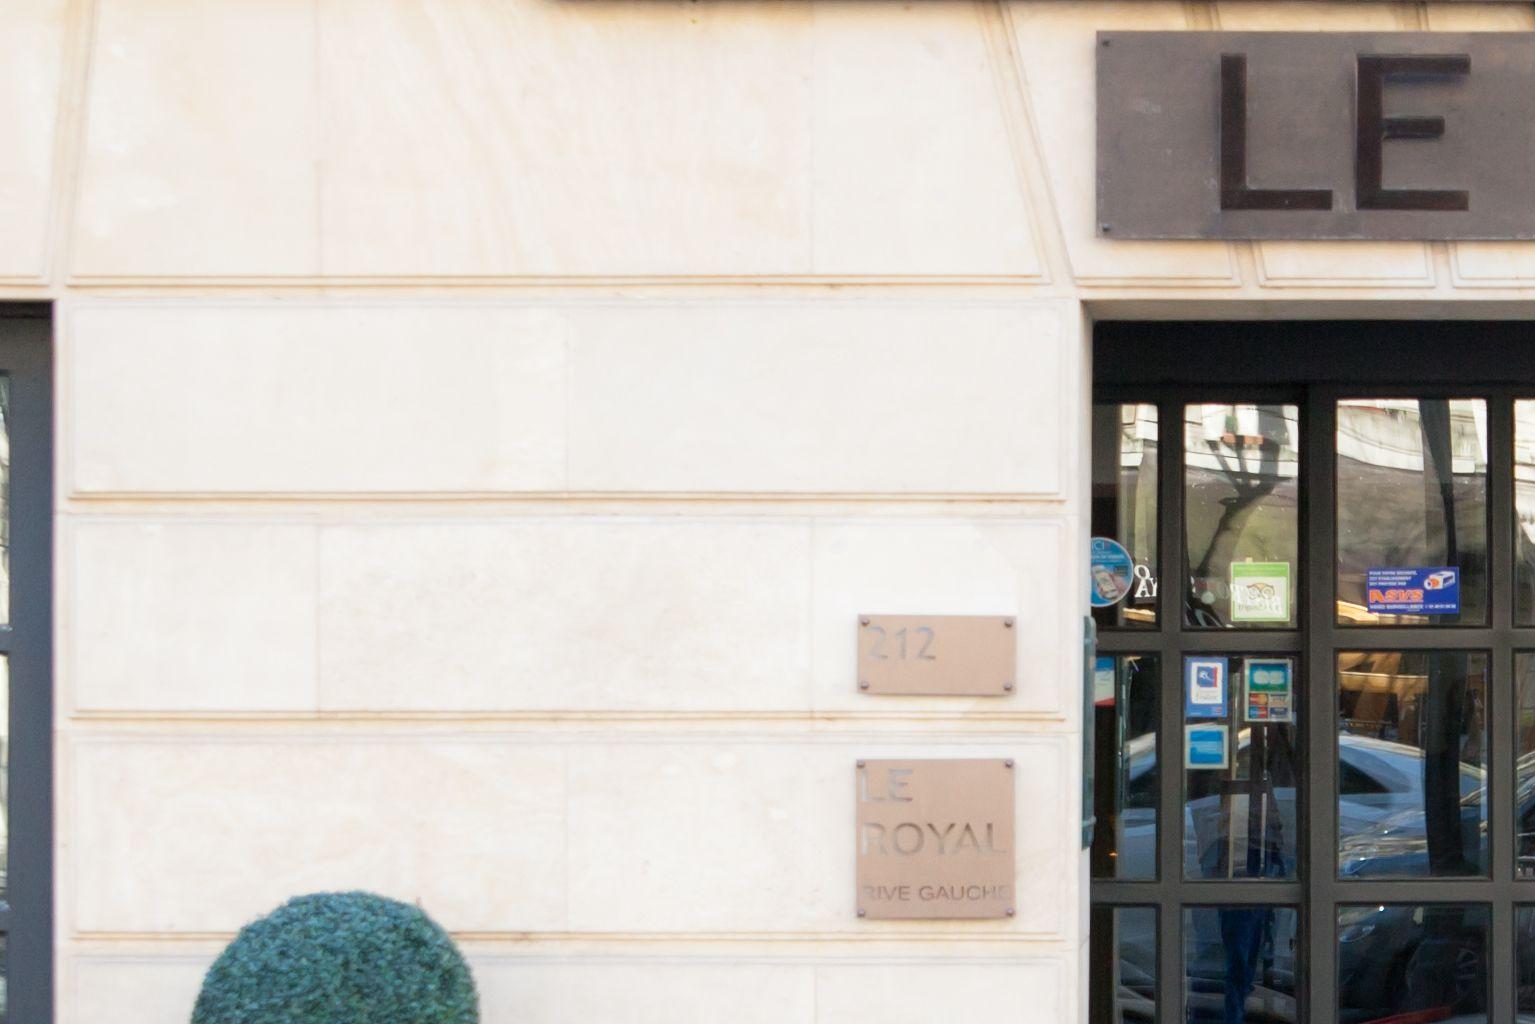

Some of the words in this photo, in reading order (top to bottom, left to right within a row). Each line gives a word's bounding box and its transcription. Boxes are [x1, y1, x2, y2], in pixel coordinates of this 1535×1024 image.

[1219, 53, 1472, 211] LE
[868, 625, 937, 661] 212
[860, 768, 914, 803] LE
[861, 821, 1007, 856] ROYAL
[863, 885, 911, 901] RIVE
